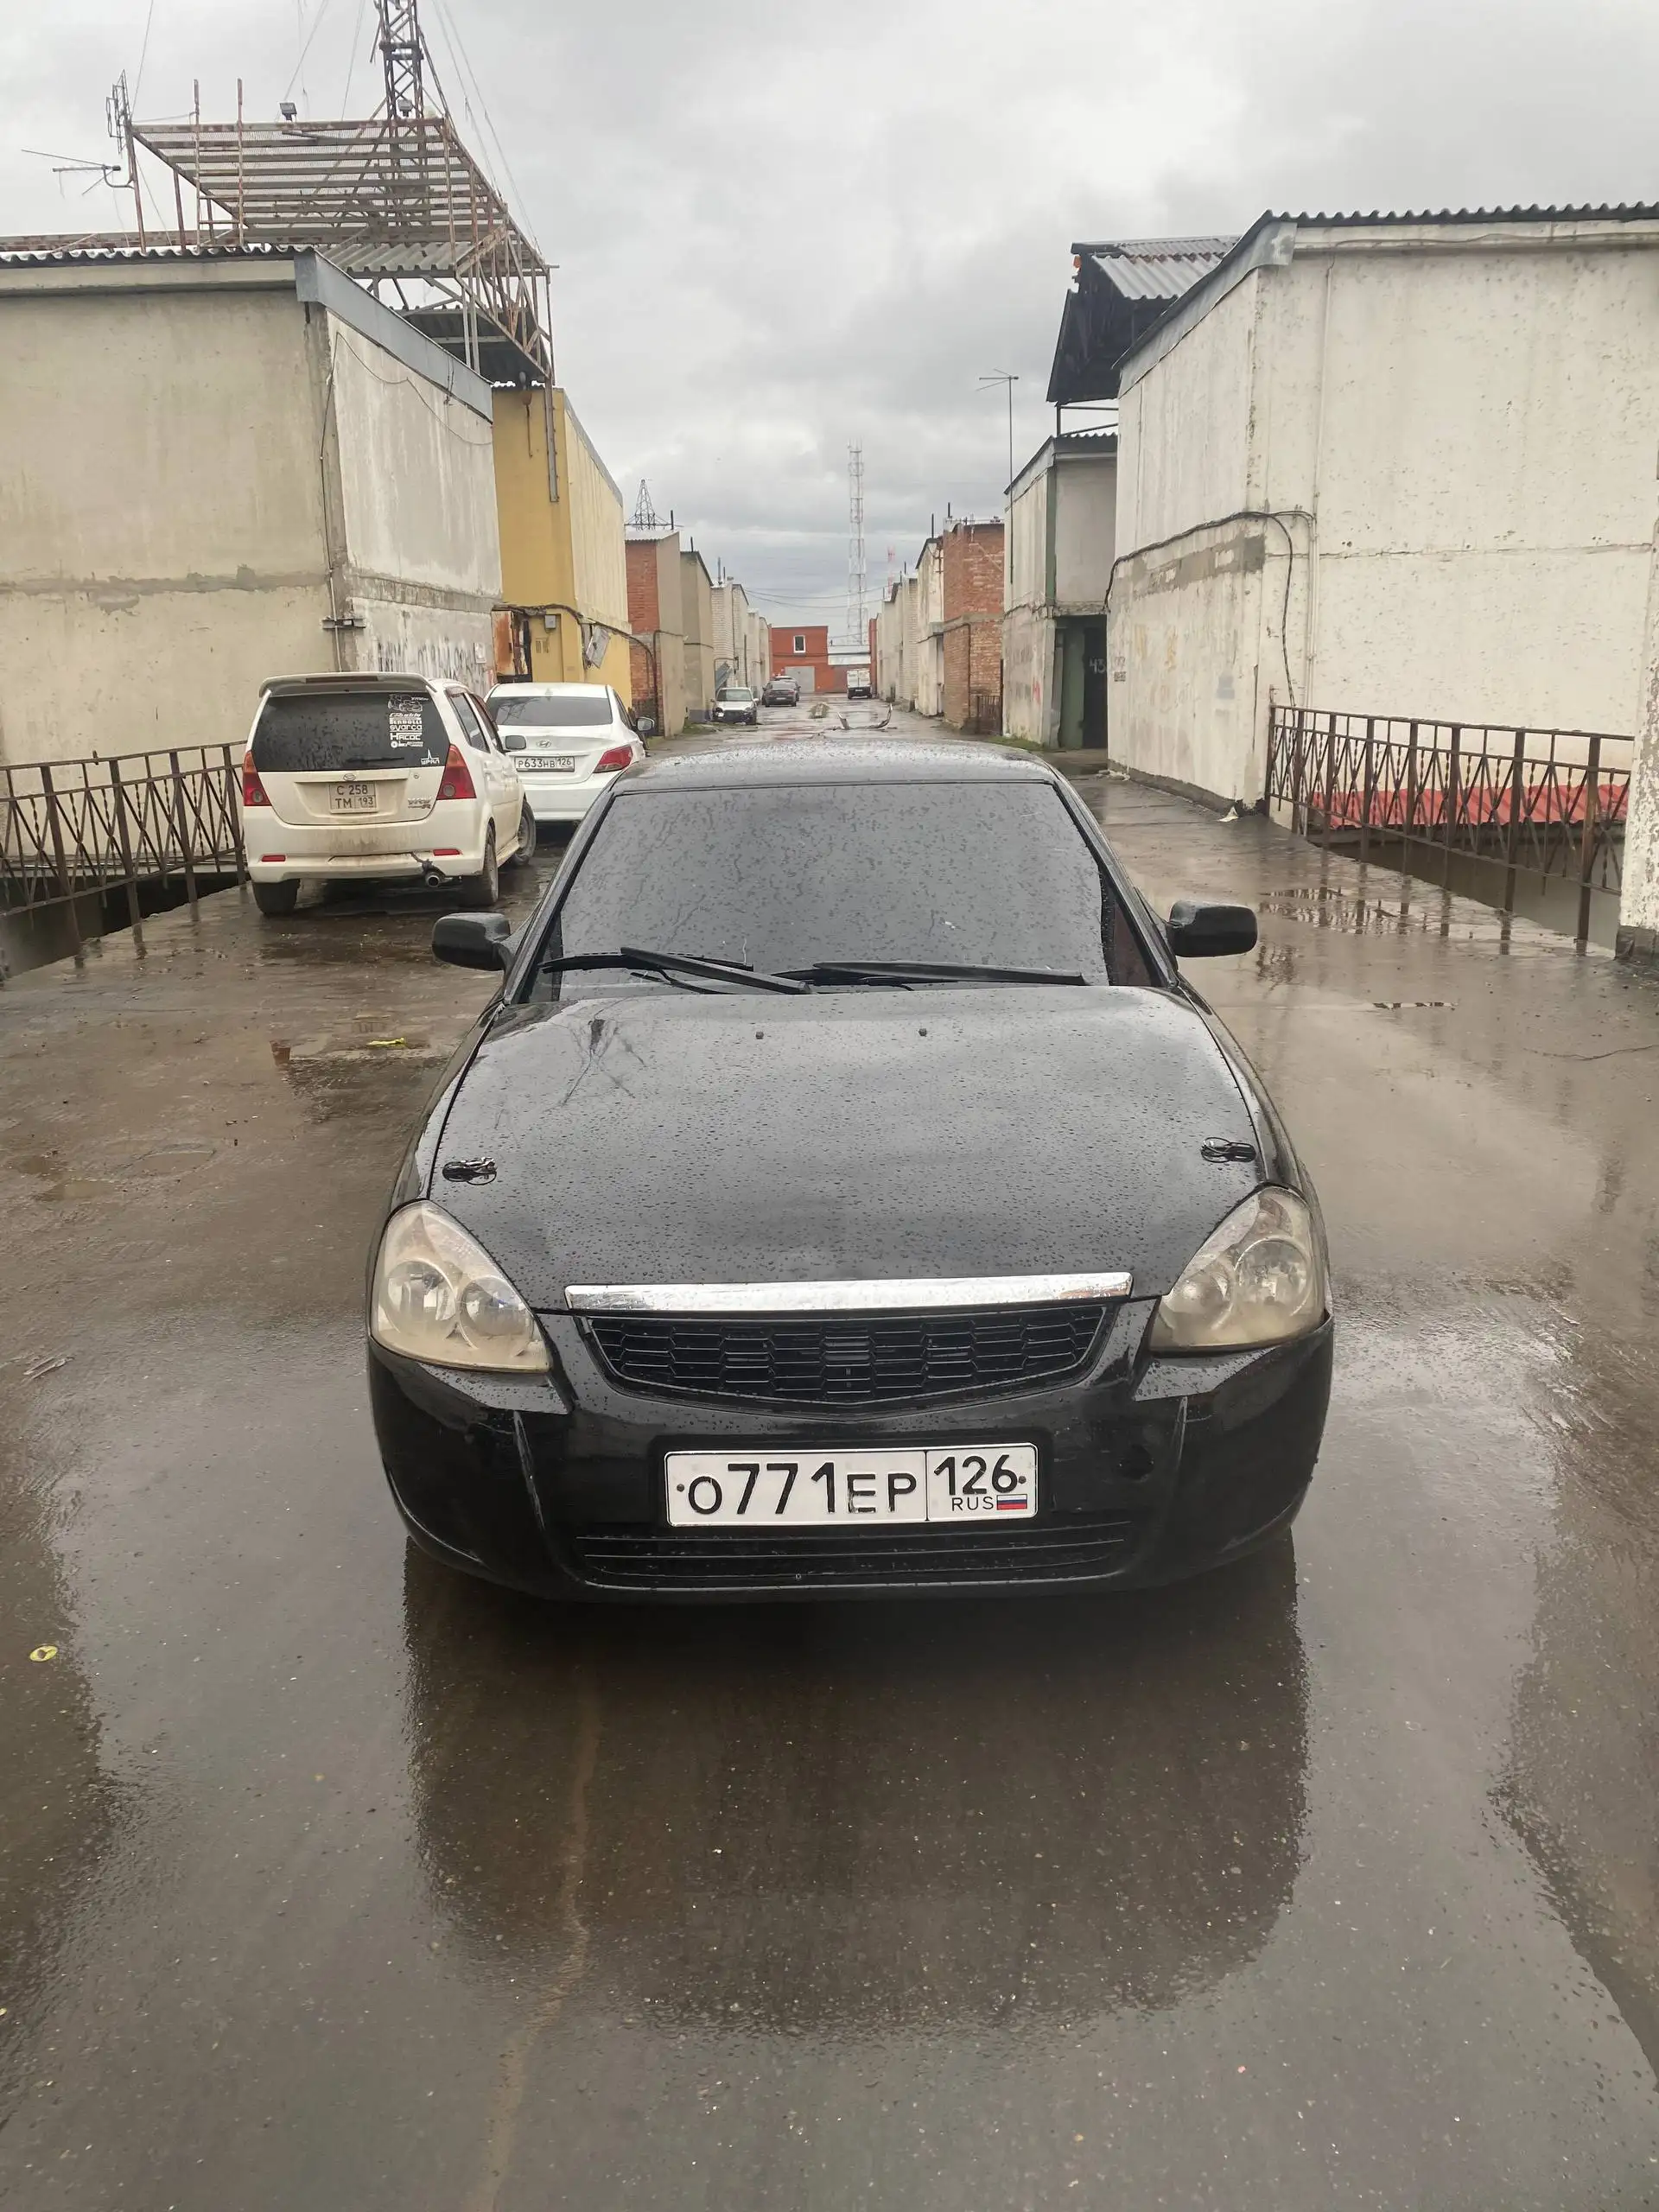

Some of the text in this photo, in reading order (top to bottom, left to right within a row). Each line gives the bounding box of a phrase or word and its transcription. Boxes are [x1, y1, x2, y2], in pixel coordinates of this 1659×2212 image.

[688, 1454, 1019, 1515] О771ЕР 126
[951, 1497, 994, 1512] RUS
